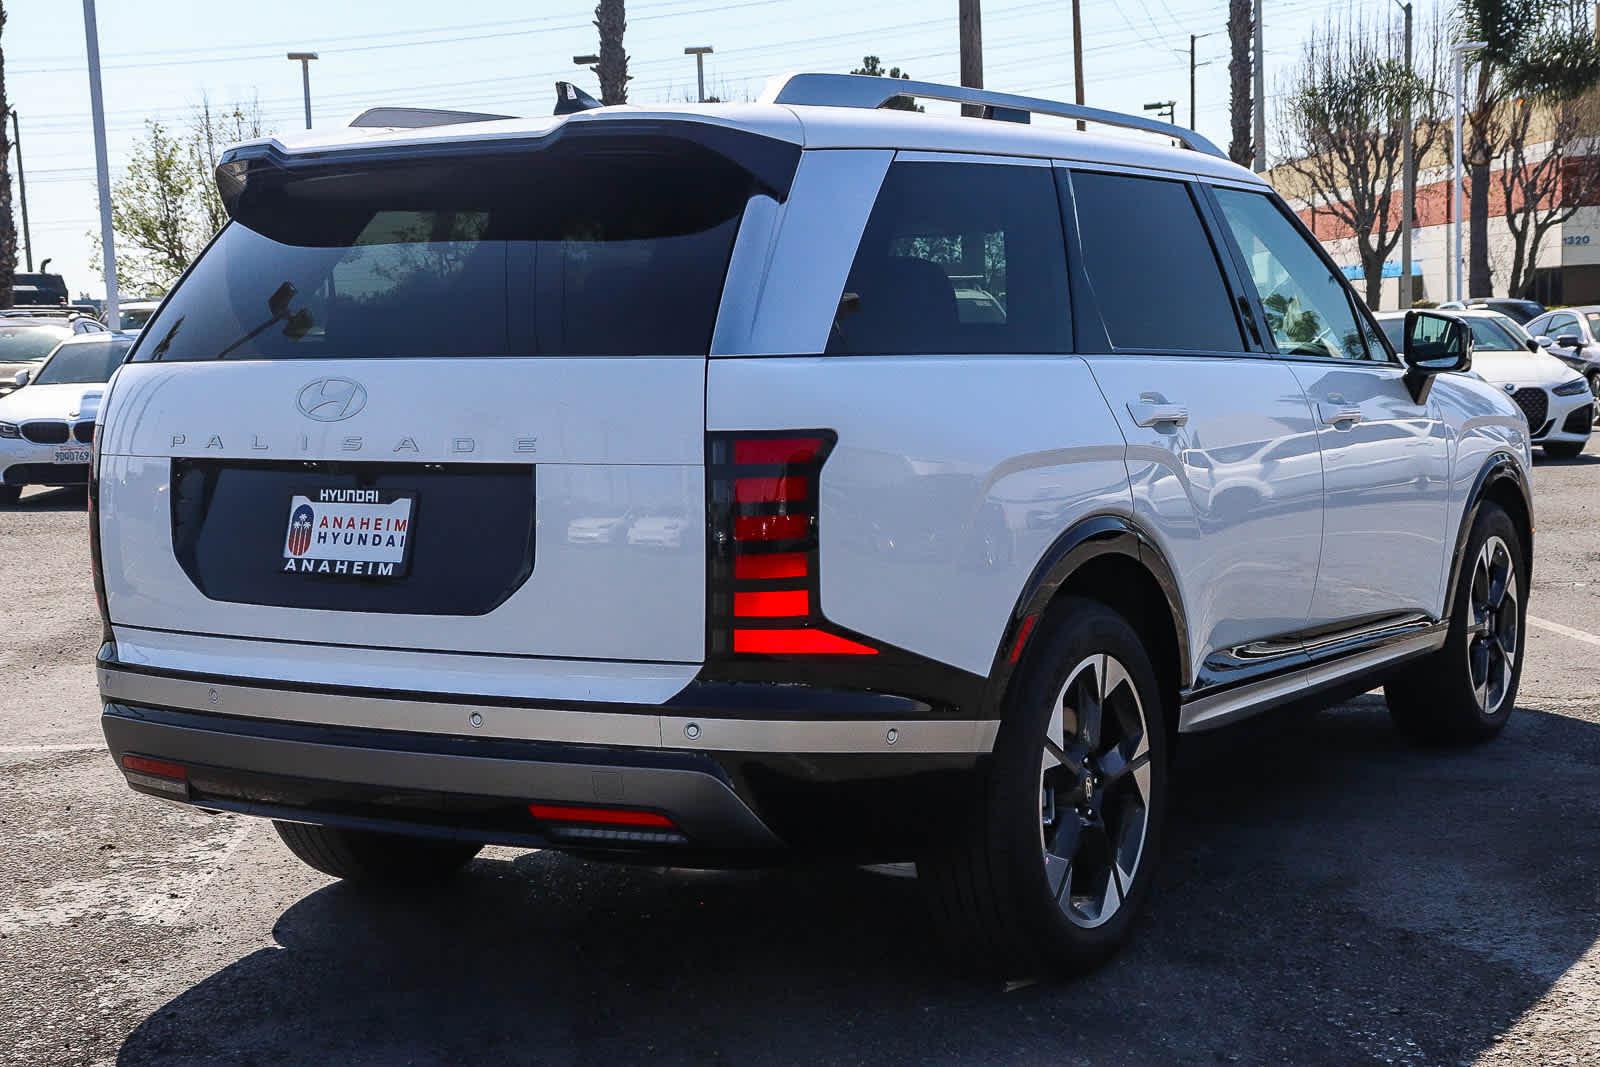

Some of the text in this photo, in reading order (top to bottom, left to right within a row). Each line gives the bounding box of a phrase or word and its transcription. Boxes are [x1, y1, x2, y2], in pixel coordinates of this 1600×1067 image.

[170, 434, 537, 453] PALISADE
[320, 489, 379, 503] HYUNDAI
[319, 515, 407, 532] ANAHEIM
[317, 531, 405, 548] HYUNDAI
[284, 558, 394, 576] ANAHEIM
